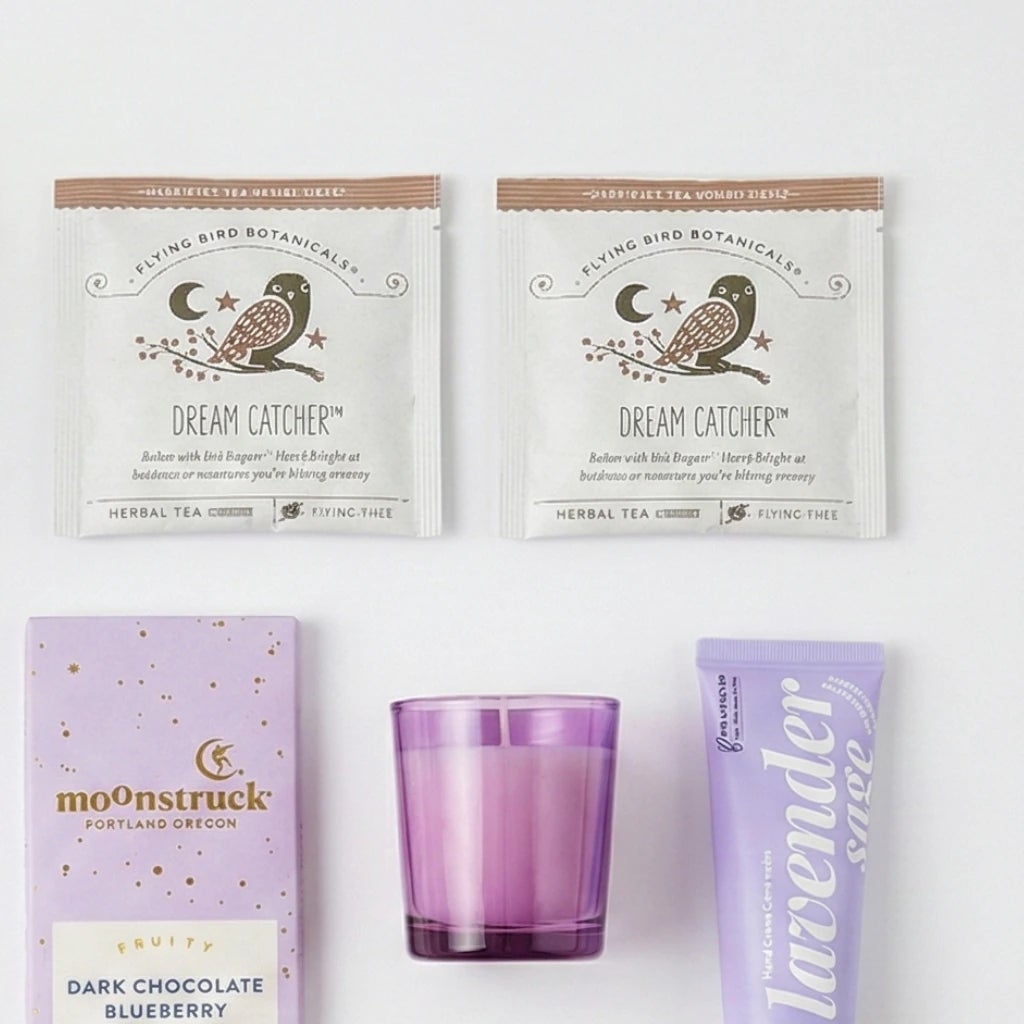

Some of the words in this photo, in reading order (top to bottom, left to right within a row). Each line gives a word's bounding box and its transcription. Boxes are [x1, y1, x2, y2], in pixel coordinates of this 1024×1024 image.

[136, 237, 193, 275] FLYING
[198, 226, 239, 246] BIRD
[581, 238, 637, 278] FLYING
[643, 229, 683, 245] BIRD
[172, 405, 239, 436] DREAM
[619, 406, 685, 438] DREAM
[182, 470, 194, 480] or
[109, 506, 167, 519] HERBAL
[173, 506, 202, 518] TEA
[556, 509, 615, 520] HERBAL
[621, 508, 649, 520] TEA
[56, 780, 268, 813] moonstruck
[845, 738, 875, 873] sage
[85, 817, 167, 830] PORTLAND
[761, 677, 838, 1022] lavender
[116, 936, 215, 955] FRUITY
[67, 977, 125, 995] DARK
[132, 976, 264, 995] CHOCOLATE
[104, 1001, 228, 1019] BLUEBERRY
